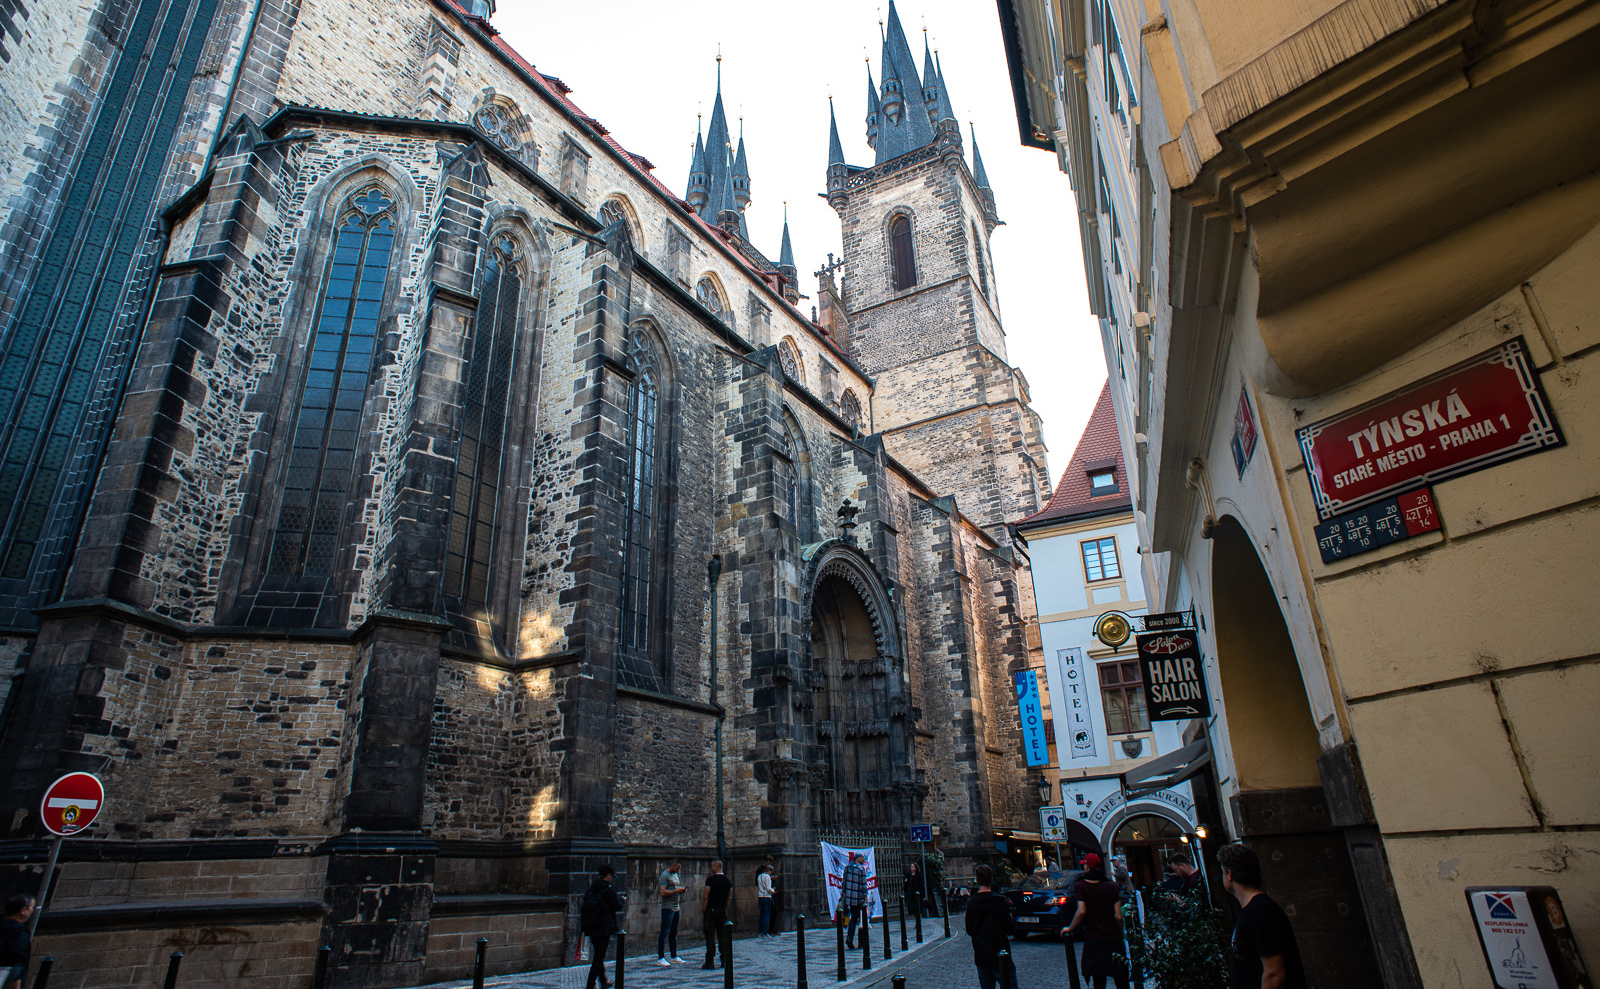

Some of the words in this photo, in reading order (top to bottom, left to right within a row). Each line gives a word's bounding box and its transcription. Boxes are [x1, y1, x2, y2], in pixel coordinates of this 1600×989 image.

[1347, 387, 1472, 459] TÝNSKÁ
[1333, 458, 1376, 489] STARÉ
[1377, 443, 1427, 473] MĚSTO
[1439, 419, 1497, 451] PRAHA
[1499, 413, 1511, 430] 1
[1385, 504, 1398, 515] 20
[1416, 494, 1428, 505] 20
[1425, 506, 1433, 516] H
[1329, 524, 1340, 534] 20
[1345, 519, 1355, 529] 15
[1357, 515, 1369, 525] 20
[1149, 619, 1164, 627] since
[1164, 616, 1180, 626] 2000
[1149, 634, 1180, 654] Salon
[1165, 640, 1190, 654] Dan
[1148, 657, 1198, 684] HAIR
[1065, 655, 1084, 723] HOTEL
[1151, 680, 1202, 703] SALON
[1025, 703, 1042, 761] HOTEL
[1095, 799, 1116, 820] CAFÉ
